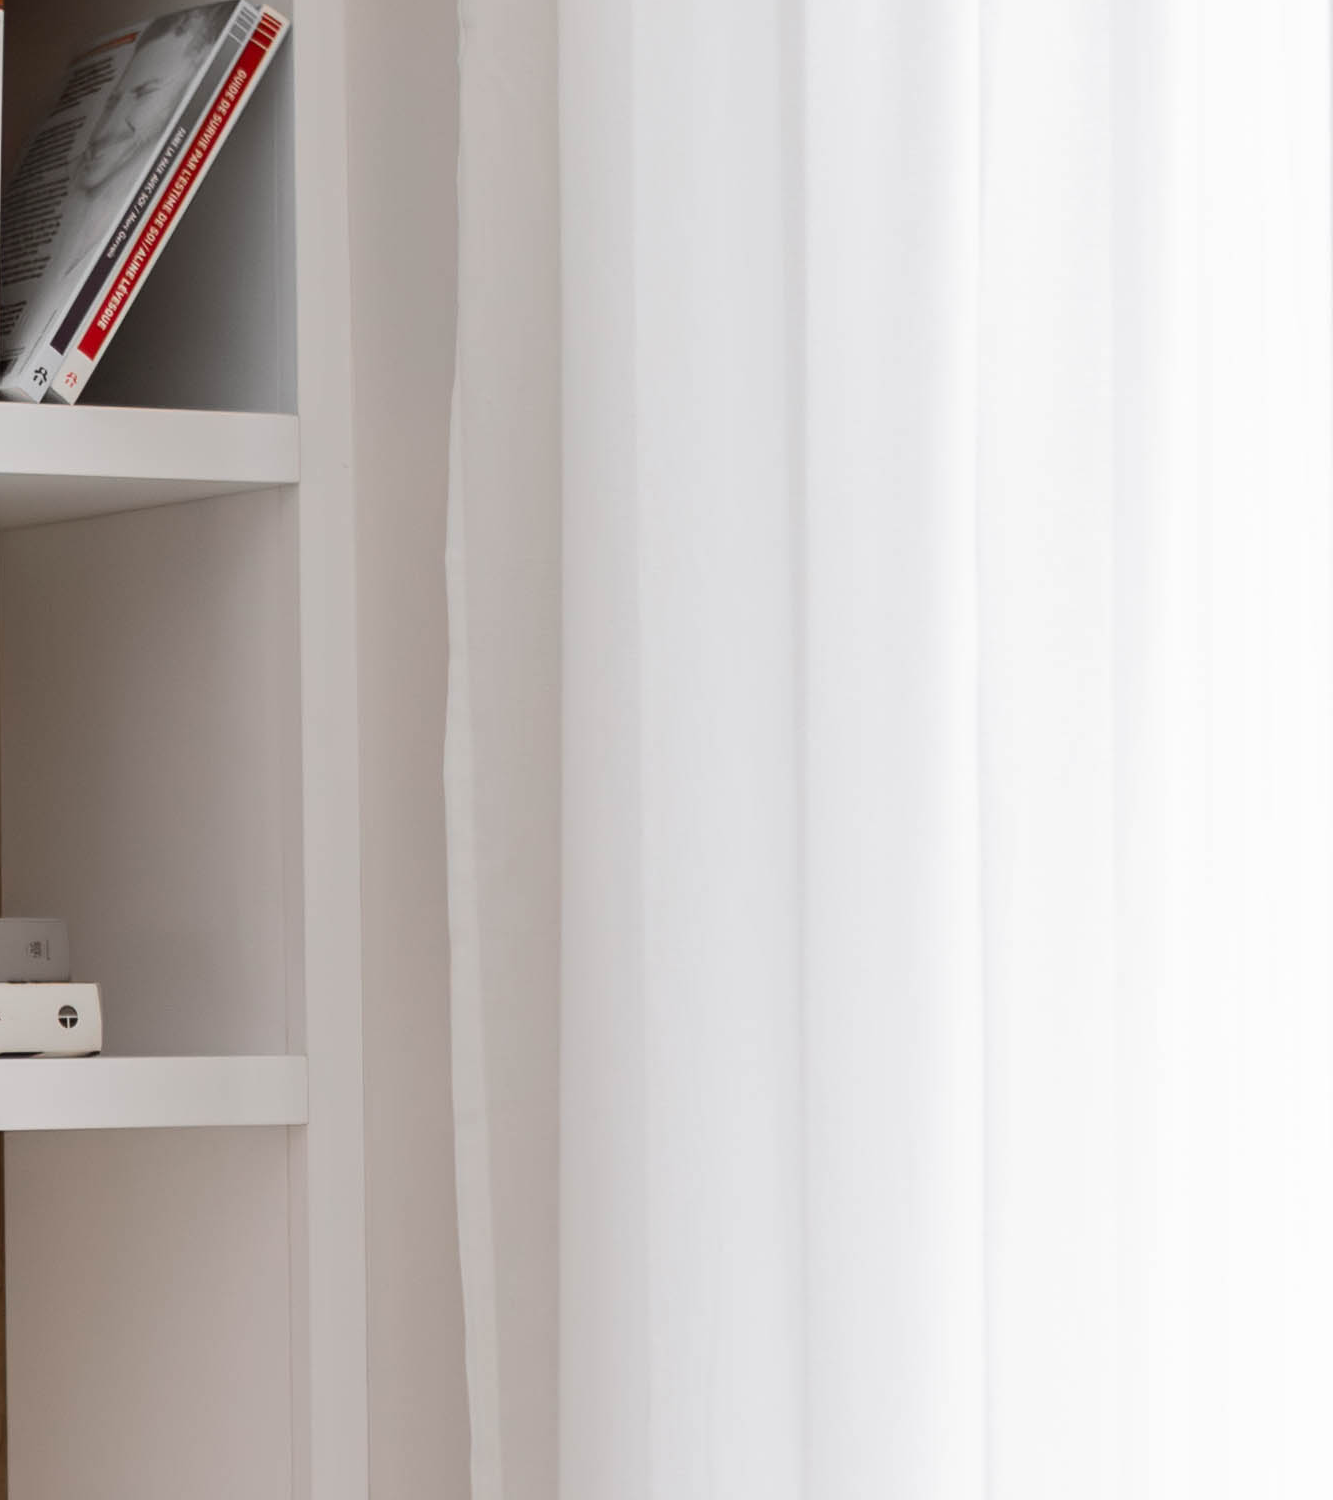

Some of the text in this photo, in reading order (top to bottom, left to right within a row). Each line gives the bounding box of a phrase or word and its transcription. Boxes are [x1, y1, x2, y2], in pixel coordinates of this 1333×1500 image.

[226, 69, 247, 100] GUIDE
[217, 99, 230, 115] DE
[199, 114, 223, 149] SURVIE
[185, 150, 203, 170] PAR
[164, 169, 191, 212] L'ESTIME
[154, 212, 168, 228] DE
[98, 278, 134, 331] LÉVESQUE
